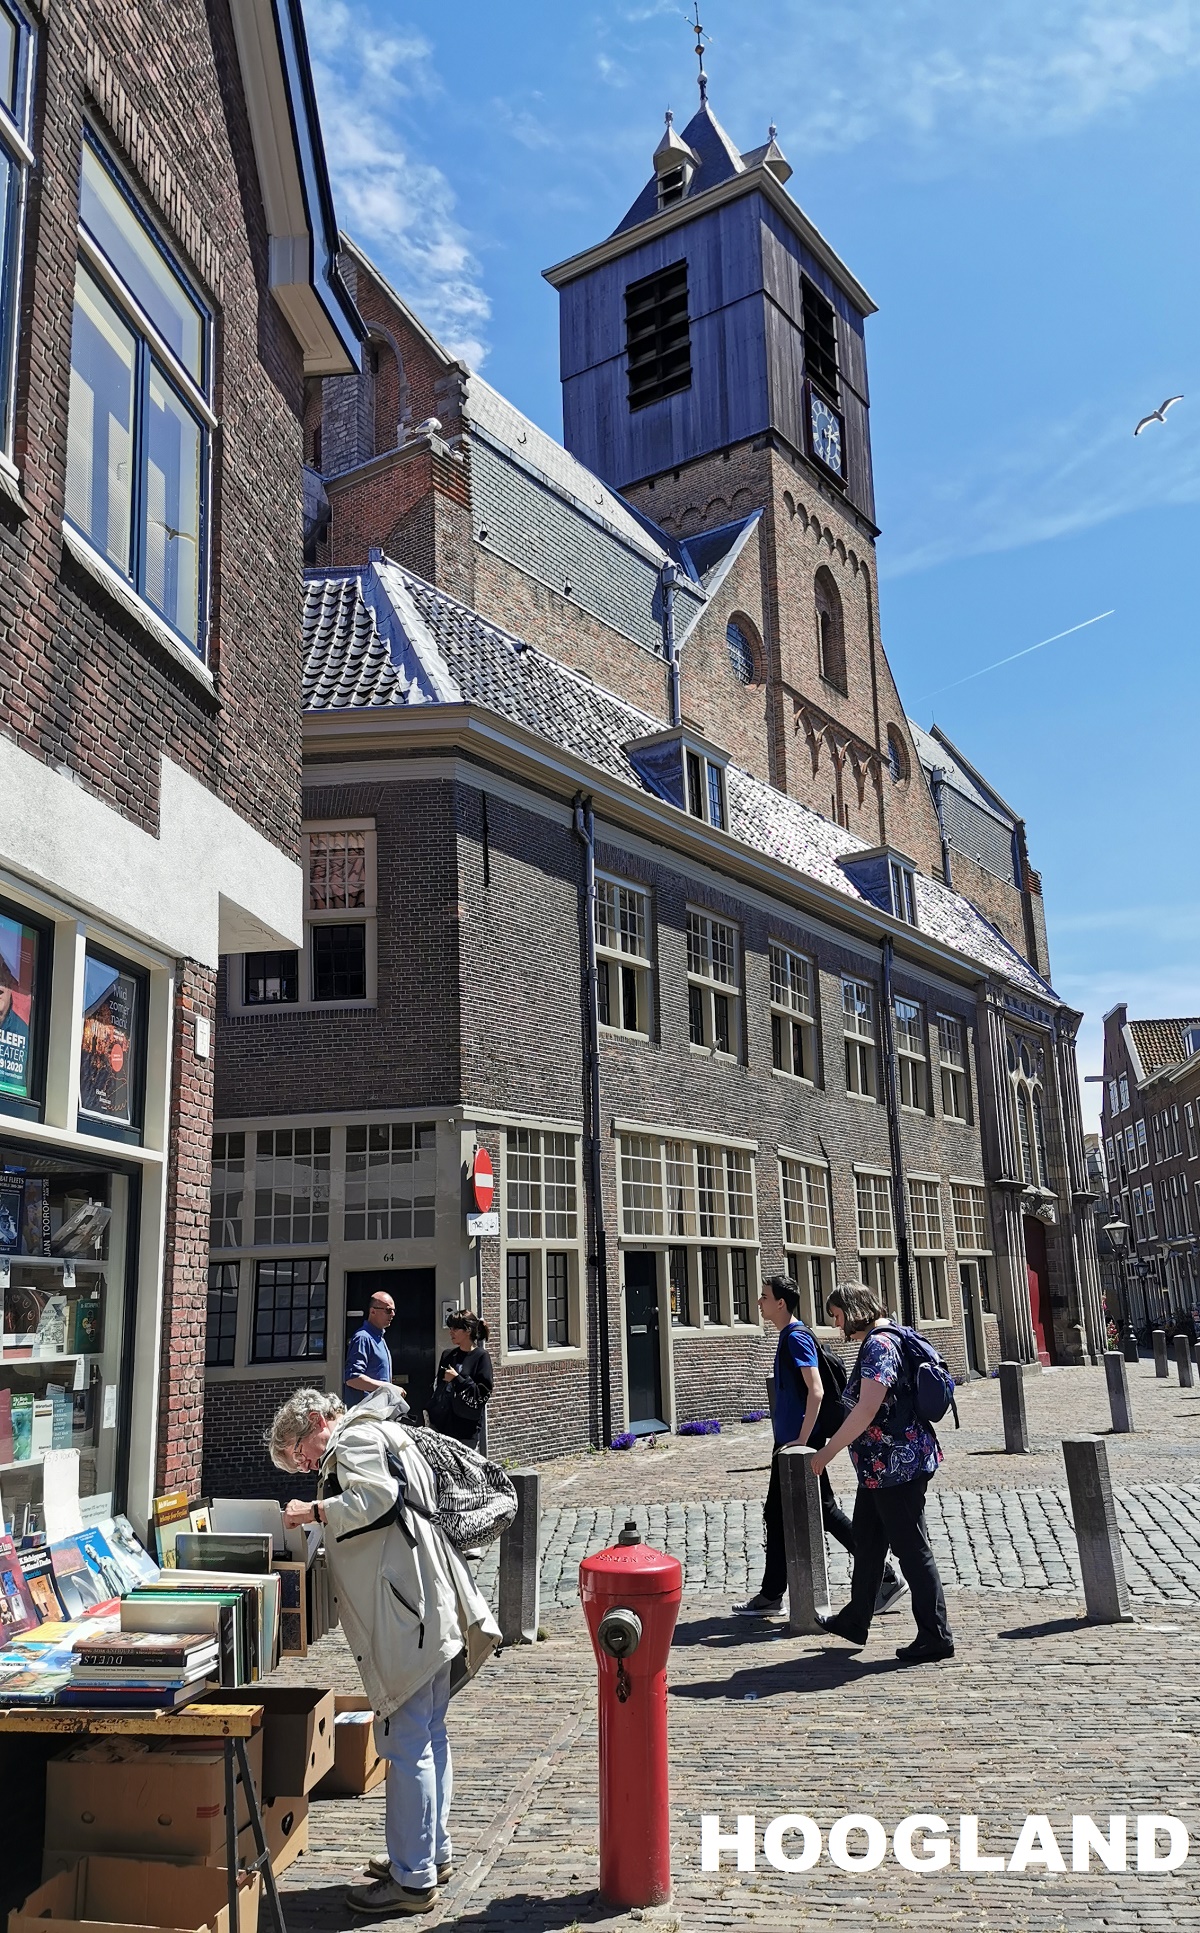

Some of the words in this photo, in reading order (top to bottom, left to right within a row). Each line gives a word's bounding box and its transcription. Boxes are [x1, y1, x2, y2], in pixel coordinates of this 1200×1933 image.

[112, 984, 128, 1000] Mid
[8, 1176, 24, 1184] FLEETS
[42, 1200, 51, 1237] TOOROP
[43, 1240, 52, 1257] JAN
[383, 1253, 395, 1262] 64
[83, 1655, 123, 1665] DUELS
